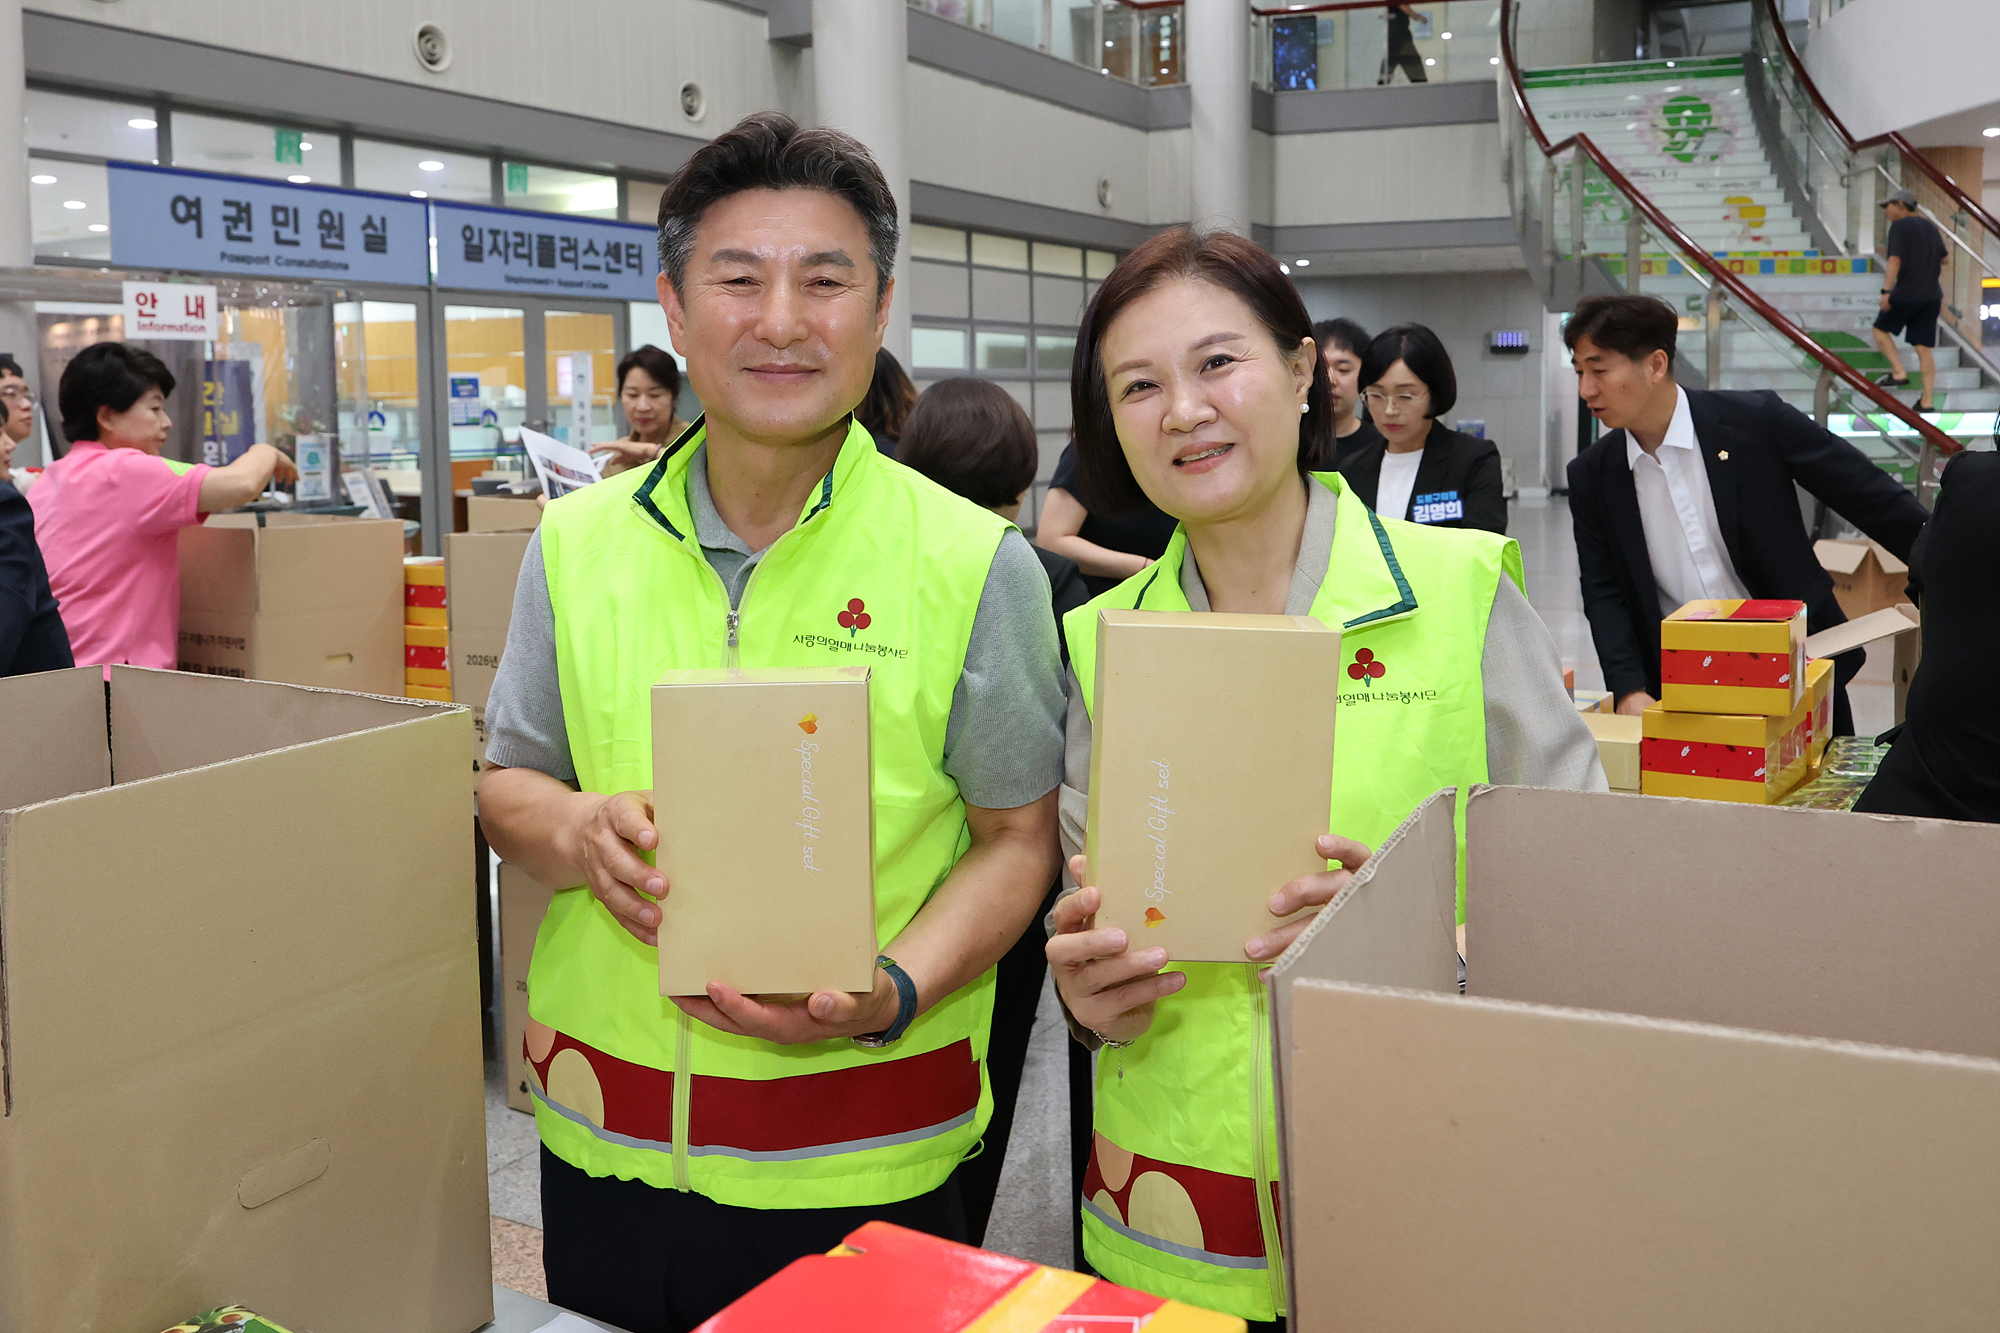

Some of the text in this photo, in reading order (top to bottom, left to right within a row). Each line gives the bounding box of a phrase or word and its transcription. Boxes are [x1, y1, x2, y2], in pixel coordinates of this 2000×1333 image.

[461, 224, 643, 276] 일자리플러스센터
[136, 320, 207, 334] Information
[1371, 689, 1438, 705] 나눔봉사단
[793, 739, 822, 876] Special Gift set
[1144, 756, 1176, 903] Special Gift set
